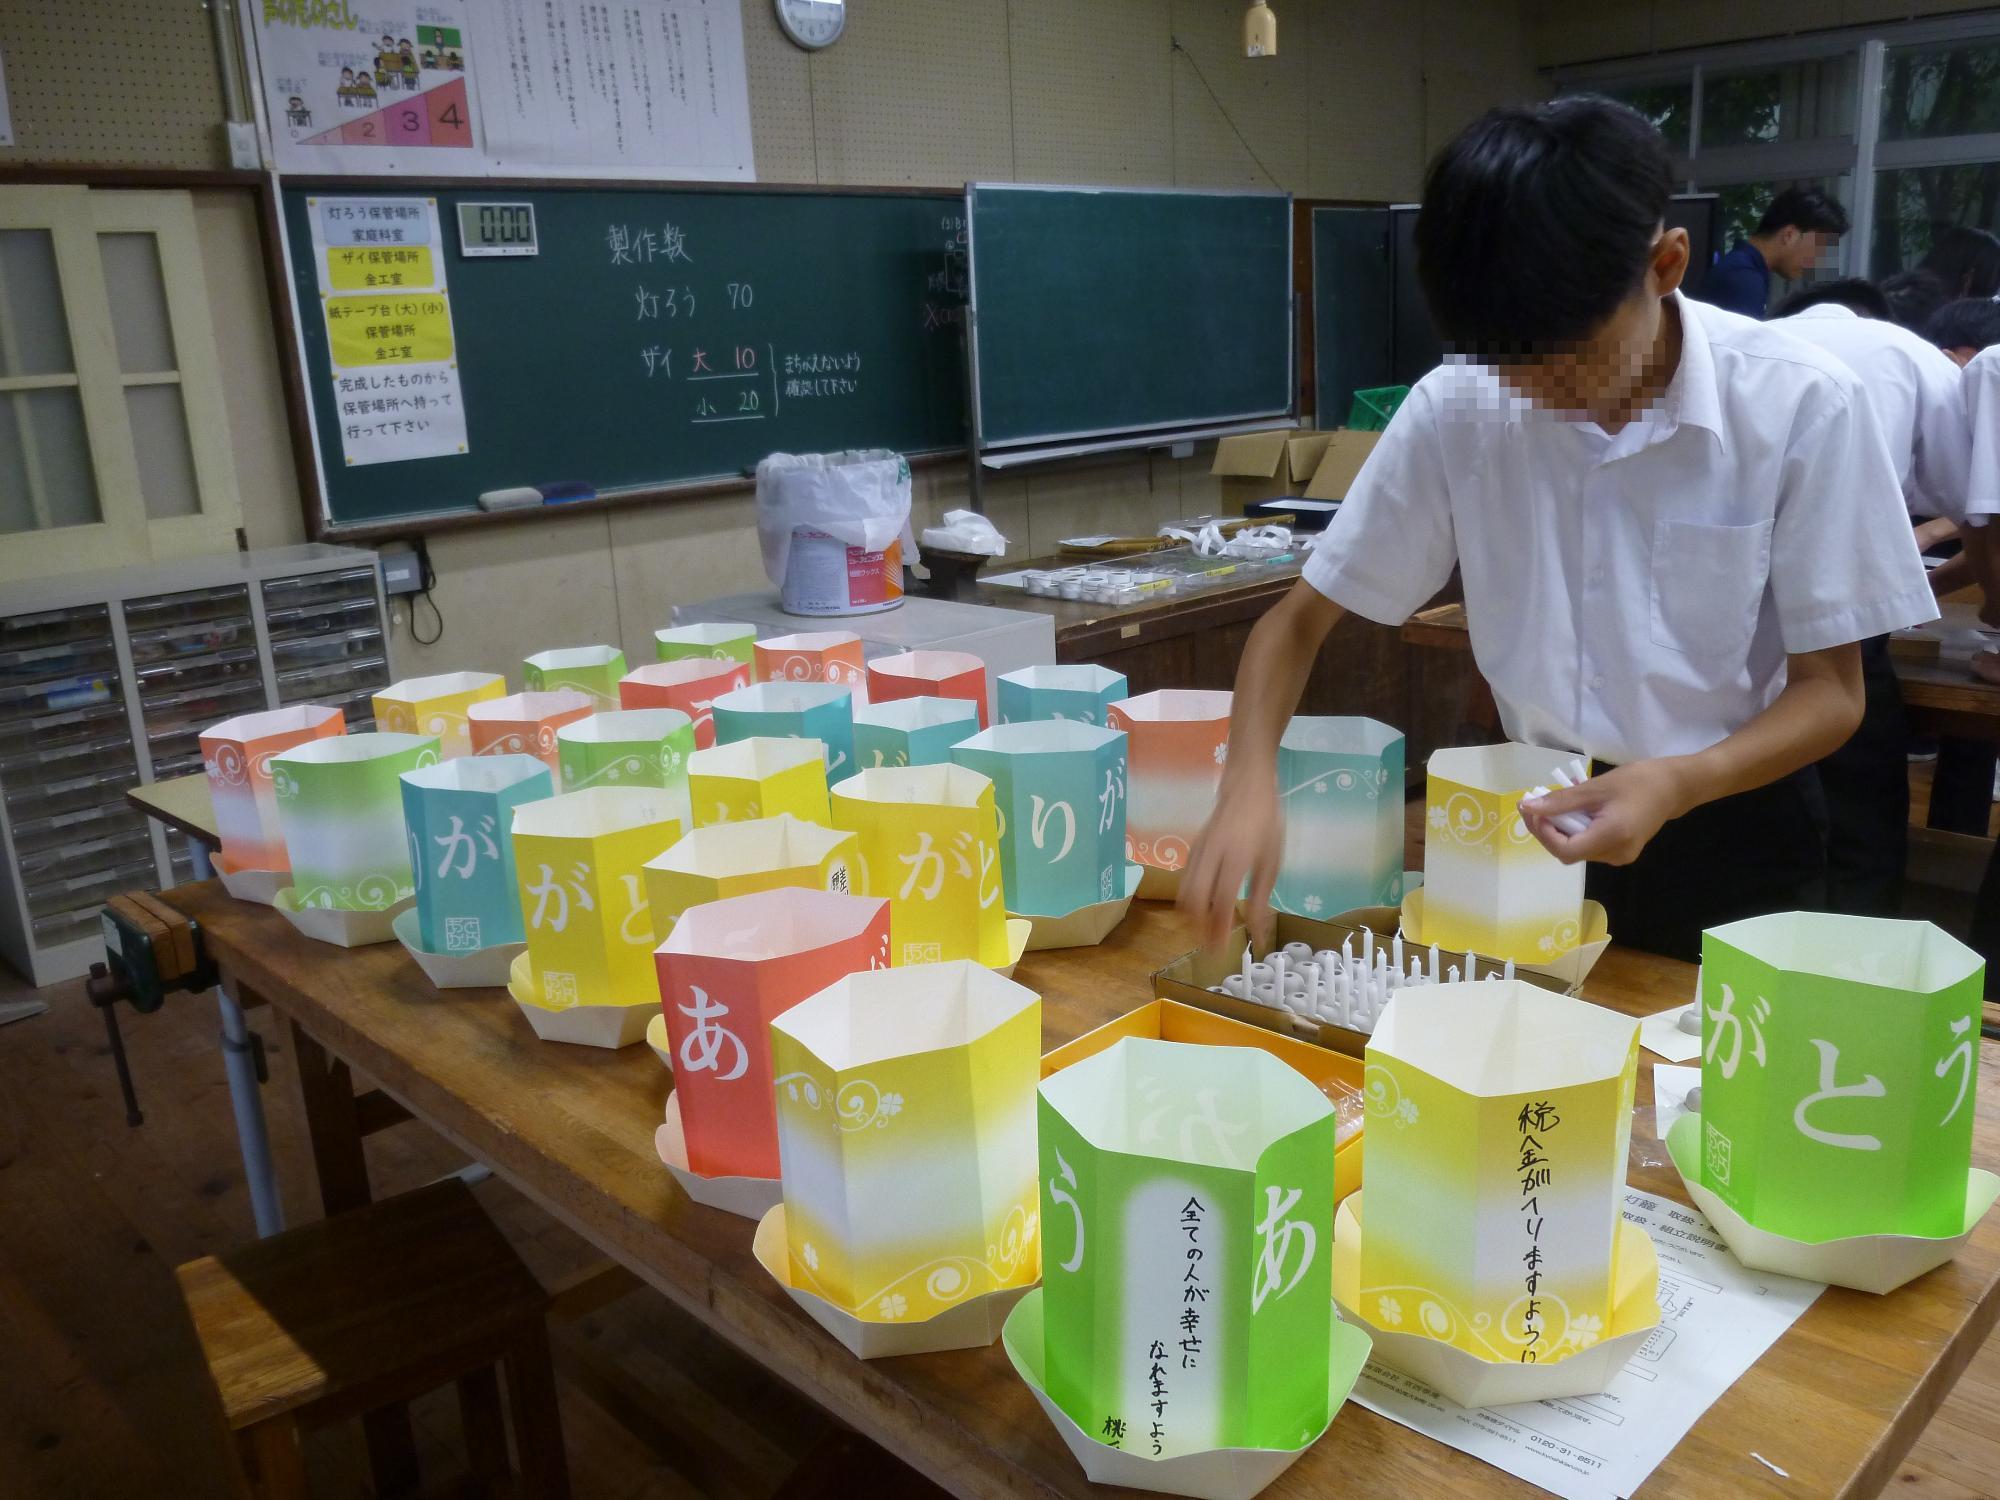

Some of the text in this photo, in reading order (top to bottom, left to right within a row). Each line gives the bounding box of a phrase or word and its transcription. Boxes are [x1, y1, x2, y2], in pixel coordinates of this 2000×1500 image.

[402, 111, 420, 132] 3
[439, 103, 464, 130] 4
[362, 122, 376, 138] 2
[327, 206, 421, 221] 灯ろう保管場所
[352, 228, 404, 242] 家庭科室
[605, 220, 695, 265] 製作数
[341, 250, 420, 265] ザイ保管場所
[364, 272, 404, 286] 金工室
[635, 283, 753, 321] 灯ろう 70
[365, 324, 416, 338] 保管場所
[375, 346, 414, 360] 金工室
[640, 345, 756, 379] ザイ 大 10
[784, 352, 861, 374] まちがえないよう
[339, 371, 450, 392] 完成したものから
[785, 378, 857, 398] 確認して下さい
[343, 395, 454, 416] 保管場所へ持って
[696, 390, 759, 416] 小 20
[346, 421, 430, 440] 行って下さい
[677, 985, 749, 1081] あ
[1049, 1146, 1085, 1273] う
[1517, 1101, 1560, 1364] 税金がへりますように
[1621, 1211, 1729, 1252] 取扱・組立説明書
[1253, 1185, 1317, 1316] あ
[1178, 1196, 1210, 1369] 全ての人が幸せに
[1148, 1340, 1169, 1456] なれますよう
[1102, 1416, 1127, 1449] 桃
[1456, 1415, 1470, 1426] FAX
[1530, 1435, 1602, 1469] 0120-31-8511
